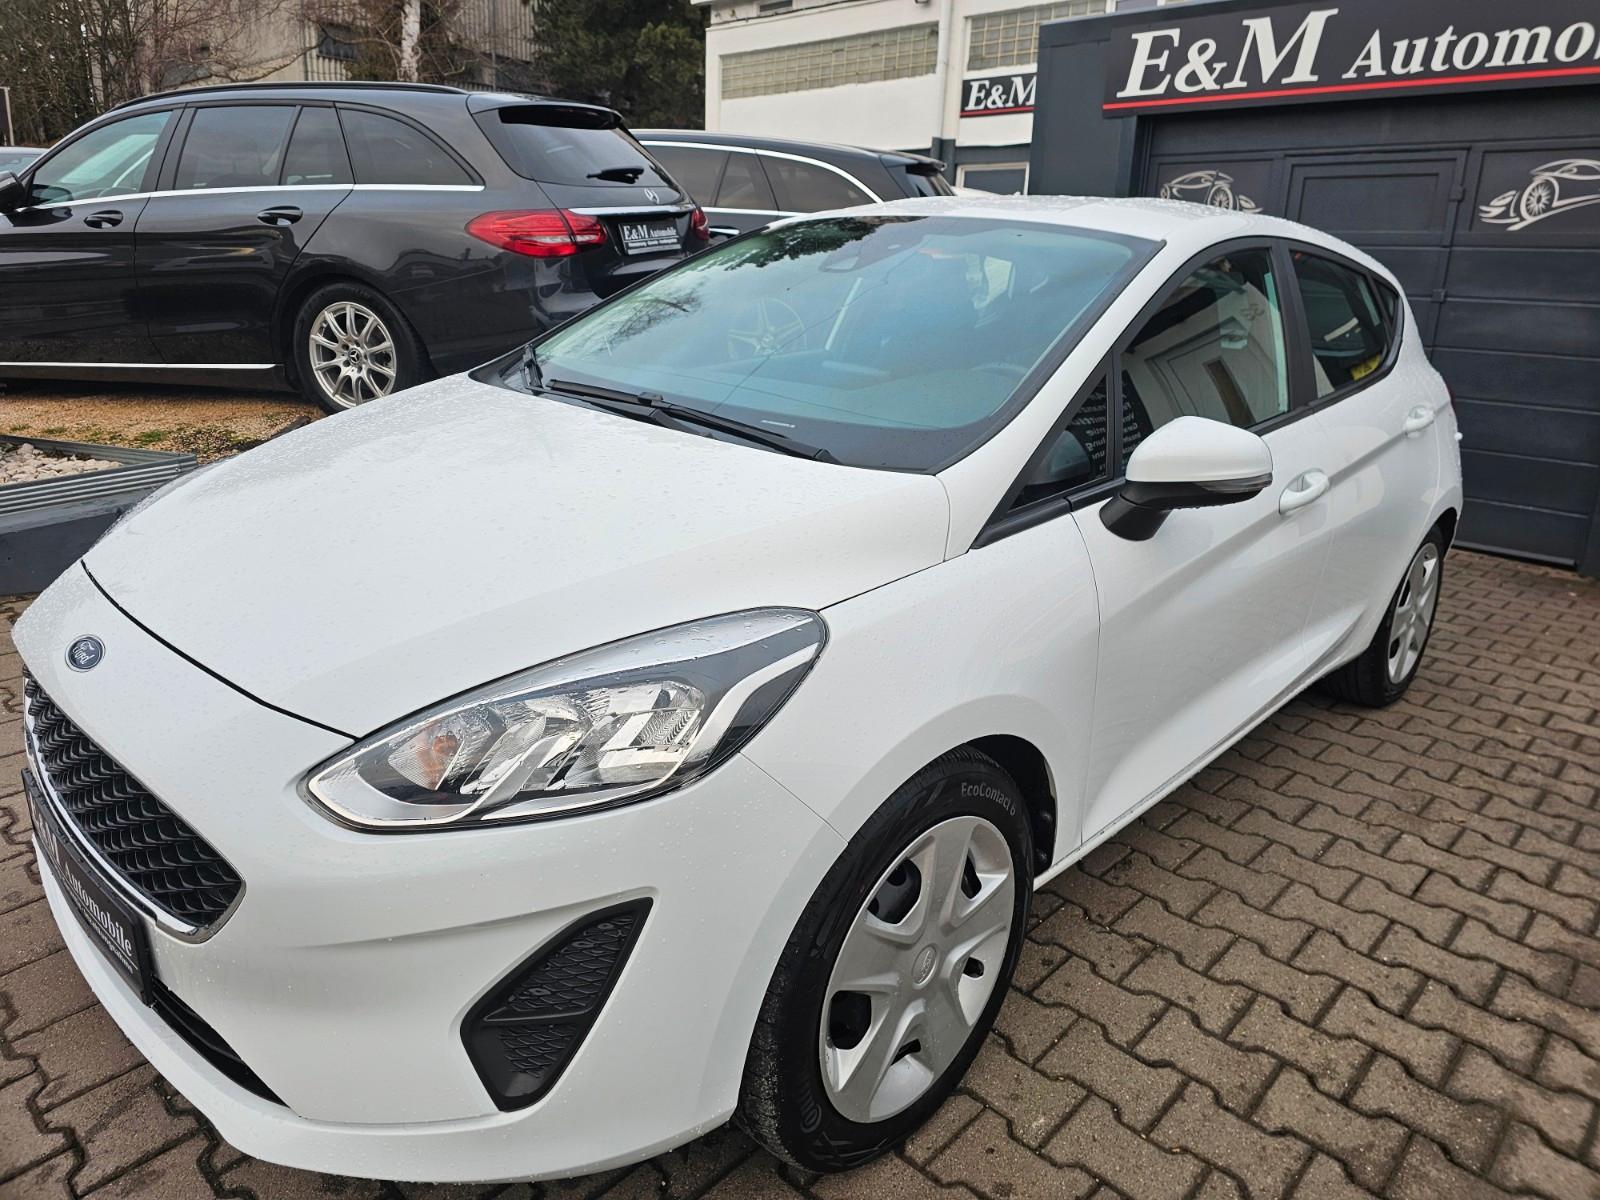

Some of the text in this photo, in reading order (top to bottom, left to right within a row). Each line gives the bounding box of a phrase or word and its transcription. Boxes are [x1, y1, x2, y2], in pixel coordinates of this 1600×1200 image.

[1116, 8, 1600, 98] E&M Automo
[964, 74, 1037, 111] E&M
[623, 224, 649, 240] E&M
[961, 781, 1010, 811] EcoContact
[65, 861, 133, 957] Automobile
